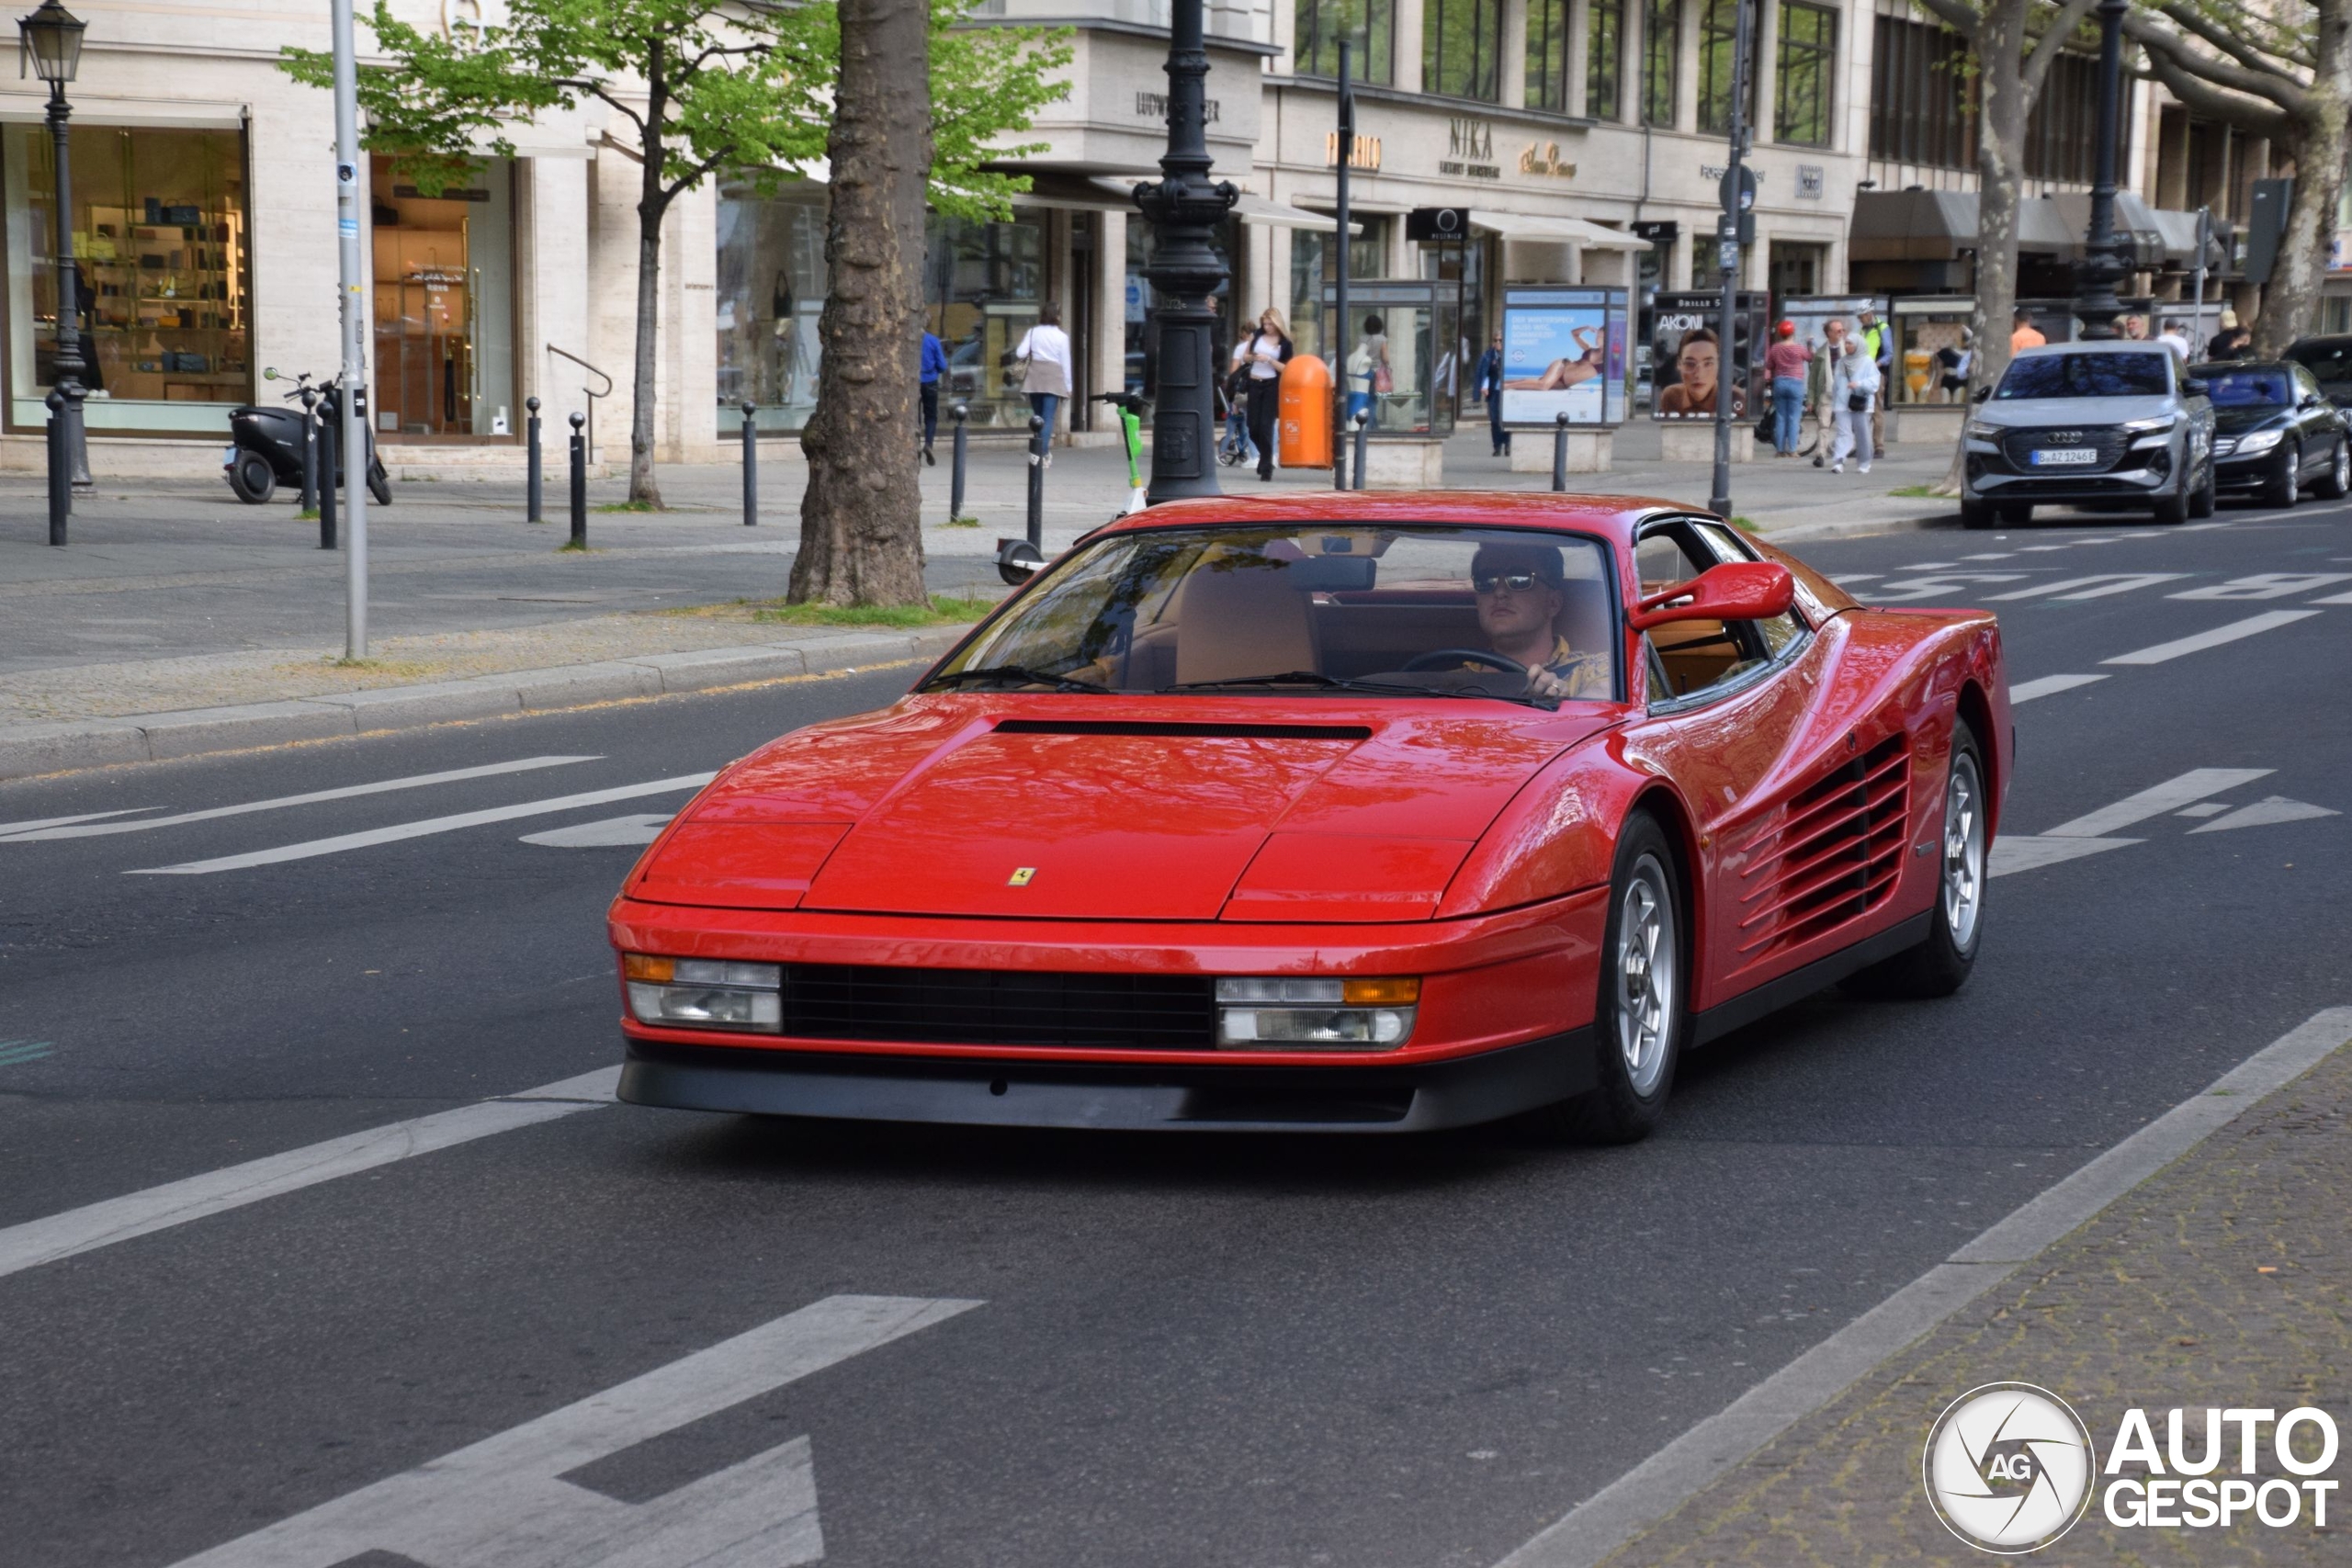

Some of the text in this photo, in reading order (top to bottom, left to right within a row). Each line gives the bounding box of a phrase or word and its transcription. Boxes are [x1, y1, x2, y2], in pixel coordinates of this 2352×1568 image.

[1136, 91, 1166, 117] LUDW
[1449, 118, 1493, 160] NIKA
[1659, 314, 1703, 331] AKONI
